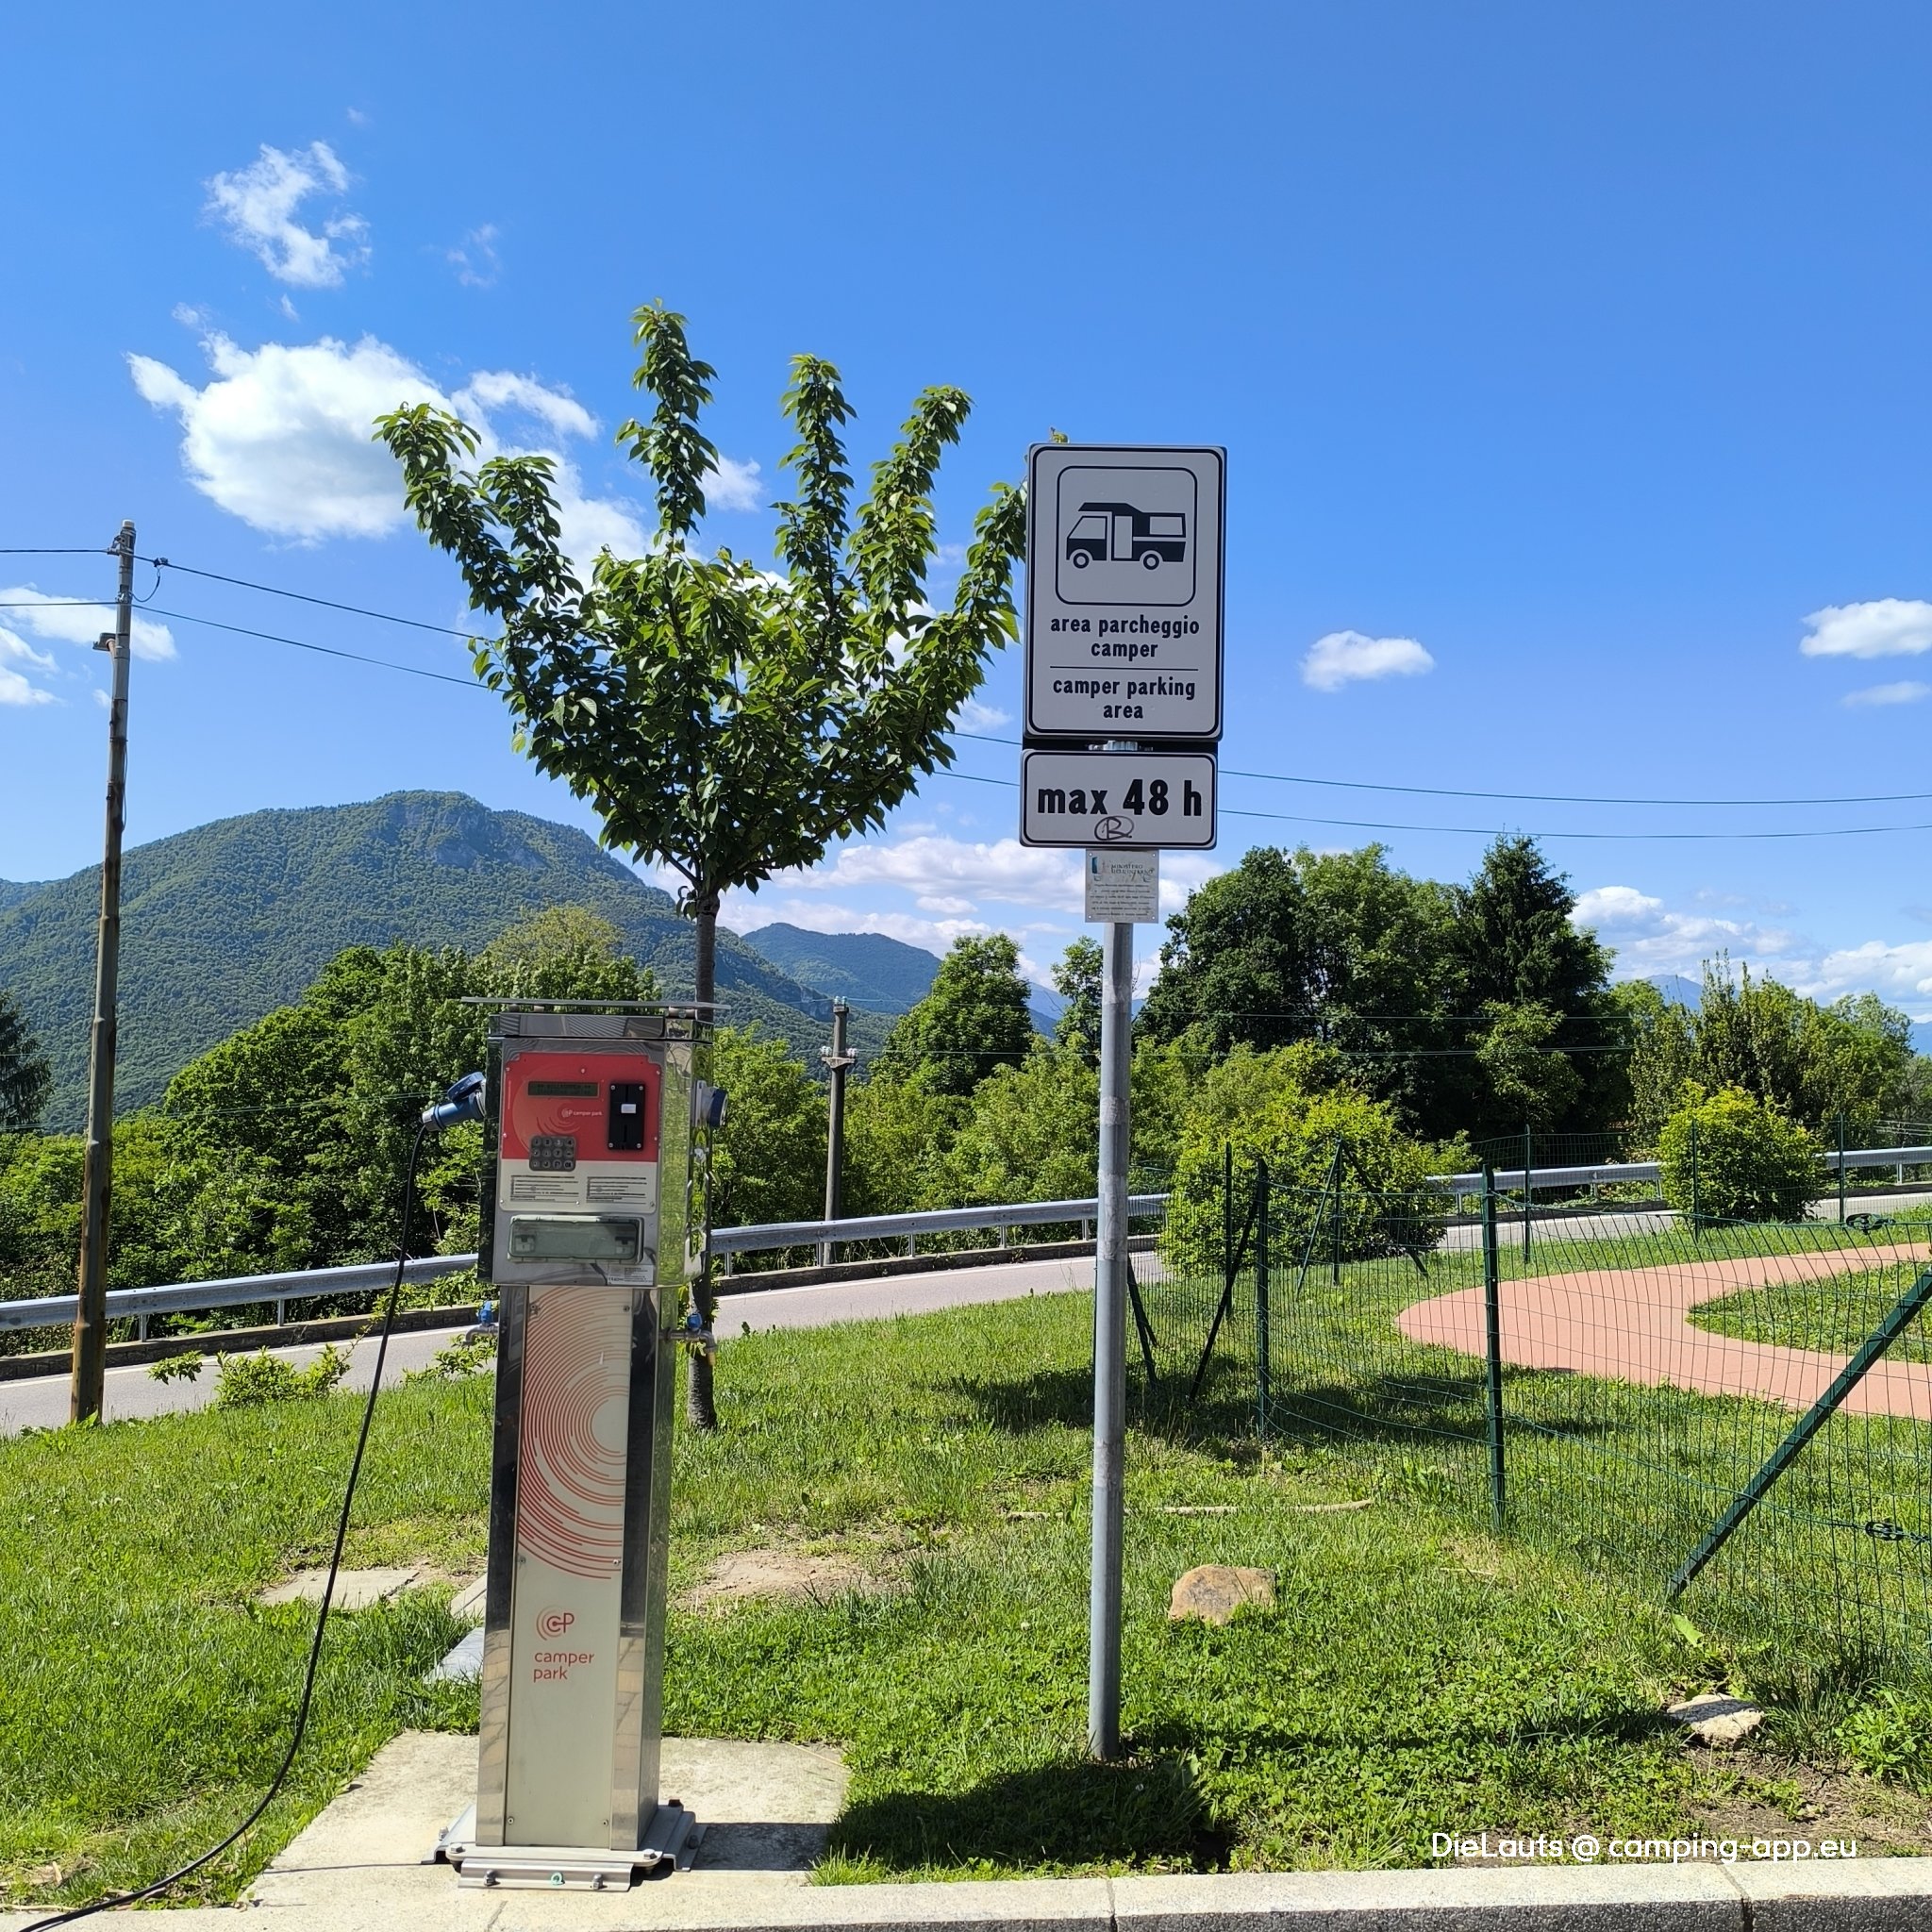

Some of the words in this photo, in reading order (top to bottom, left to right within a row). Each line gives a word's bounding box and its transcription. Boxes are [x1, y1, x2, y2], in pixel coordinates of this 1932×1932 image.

[1050, 618, 1091, 633] area
[1098, 614, 1200, 639] parcheggio
[1091, 642, 1158, 661] camper
[1053, 679, 1120, 699] camper
[1126, 676, 1195, 700] parking
[1103, 704, 1143, 719] area
[1038, 788, 1108, 815] max
[1123, 778, 1169, 816] 48
[1183, 779, 1202, 817] h
[534, 1652, 595, 1667] camper
[533, 1665, 568, 1683] park
